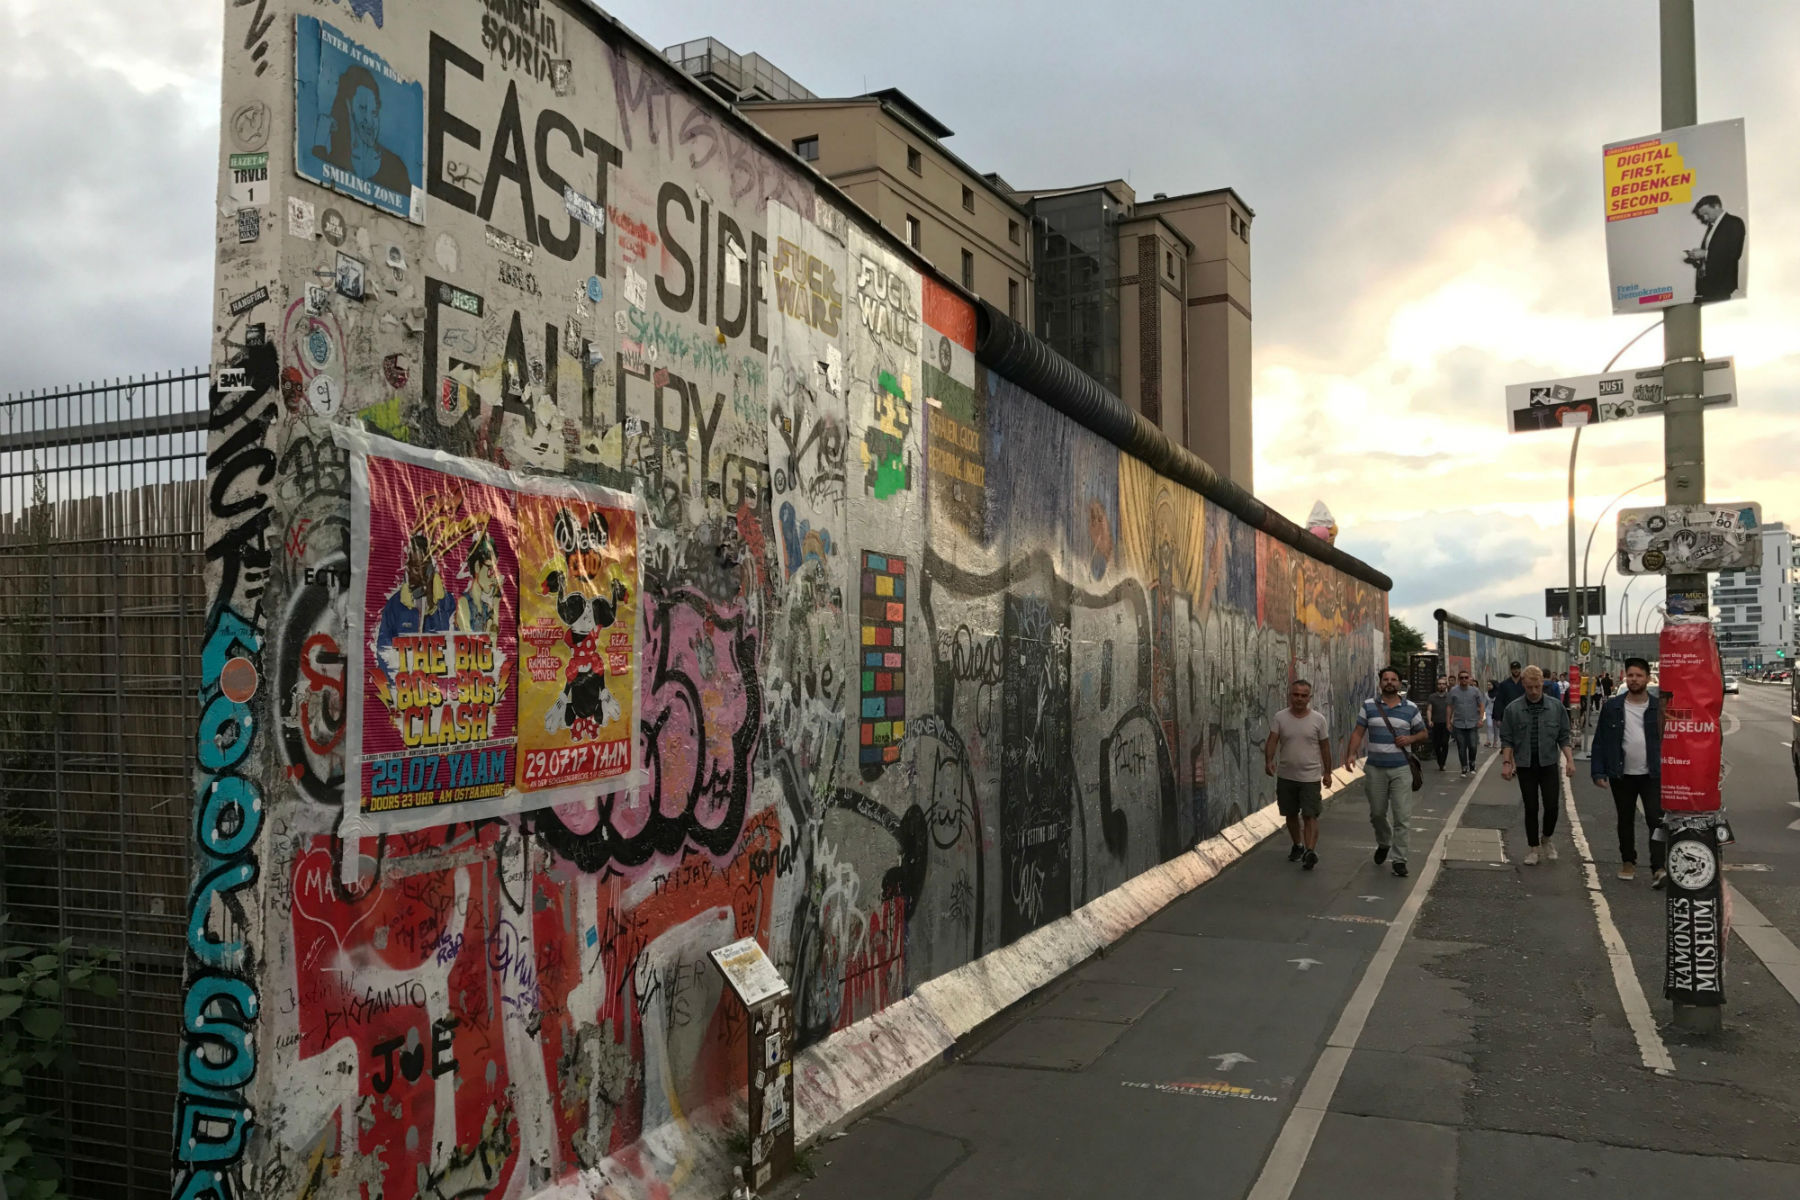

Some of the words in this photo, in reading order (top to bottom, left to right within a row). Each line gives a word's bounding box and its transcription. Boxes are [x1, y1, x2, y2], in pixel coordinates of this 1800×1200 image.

[321, 30, 349, 53] ENTER
[350, 45, 362, 62] AT
[362, 52, 382, 73] OWN
[427, 30, 623, 278] EAST
[1616, 147, 1673, 168] DIGITAL
[1621, 163, 1665, 181] FIRST.
[234, 167, 268, 184] TRVLR
[322, 163, 372, 196] SMILING
[373, 181, 403, 209] ZONE
[1611, 172, 1691, 197] BEDENKEN
[248, 188, 254, 202] 1
[1611, 191, 1673, 211] SECOND.
[655, 181, 768, 355] SIDE
[773, 236, 842, 307] FUCK
[232, 288, 267, 313] HANGFIRE
[774, 271, 842, 338] WARS
[857, 253, 918, 324] FUCK
[857, 293, 918, 357] WALL
[1600, 381, 1623, 394] JUST
[392, 638, 448, 674] THE
[453, 635, 494, 673] BIG
[402, 703, 492, 748] CLASH
[1663, 721, 1715, 733] MUSEUM
[447, 750, 507, 788] YAAM
[591, 740, 628, 770] YAAM
[370, 796, 401, 812] DOORS
[401, 794, 412, 807] 23
[415, 791, 434, 806] UHR
[439, 789, 452, 804] AM
[454, 783, 505, 800] OSTBAHNHOF
[1673, 897, 1692, 991] RAMONES
[1694, 899, 1716, 992] MUSEUM
[1154, 1083, 1196, 1094] WALL
